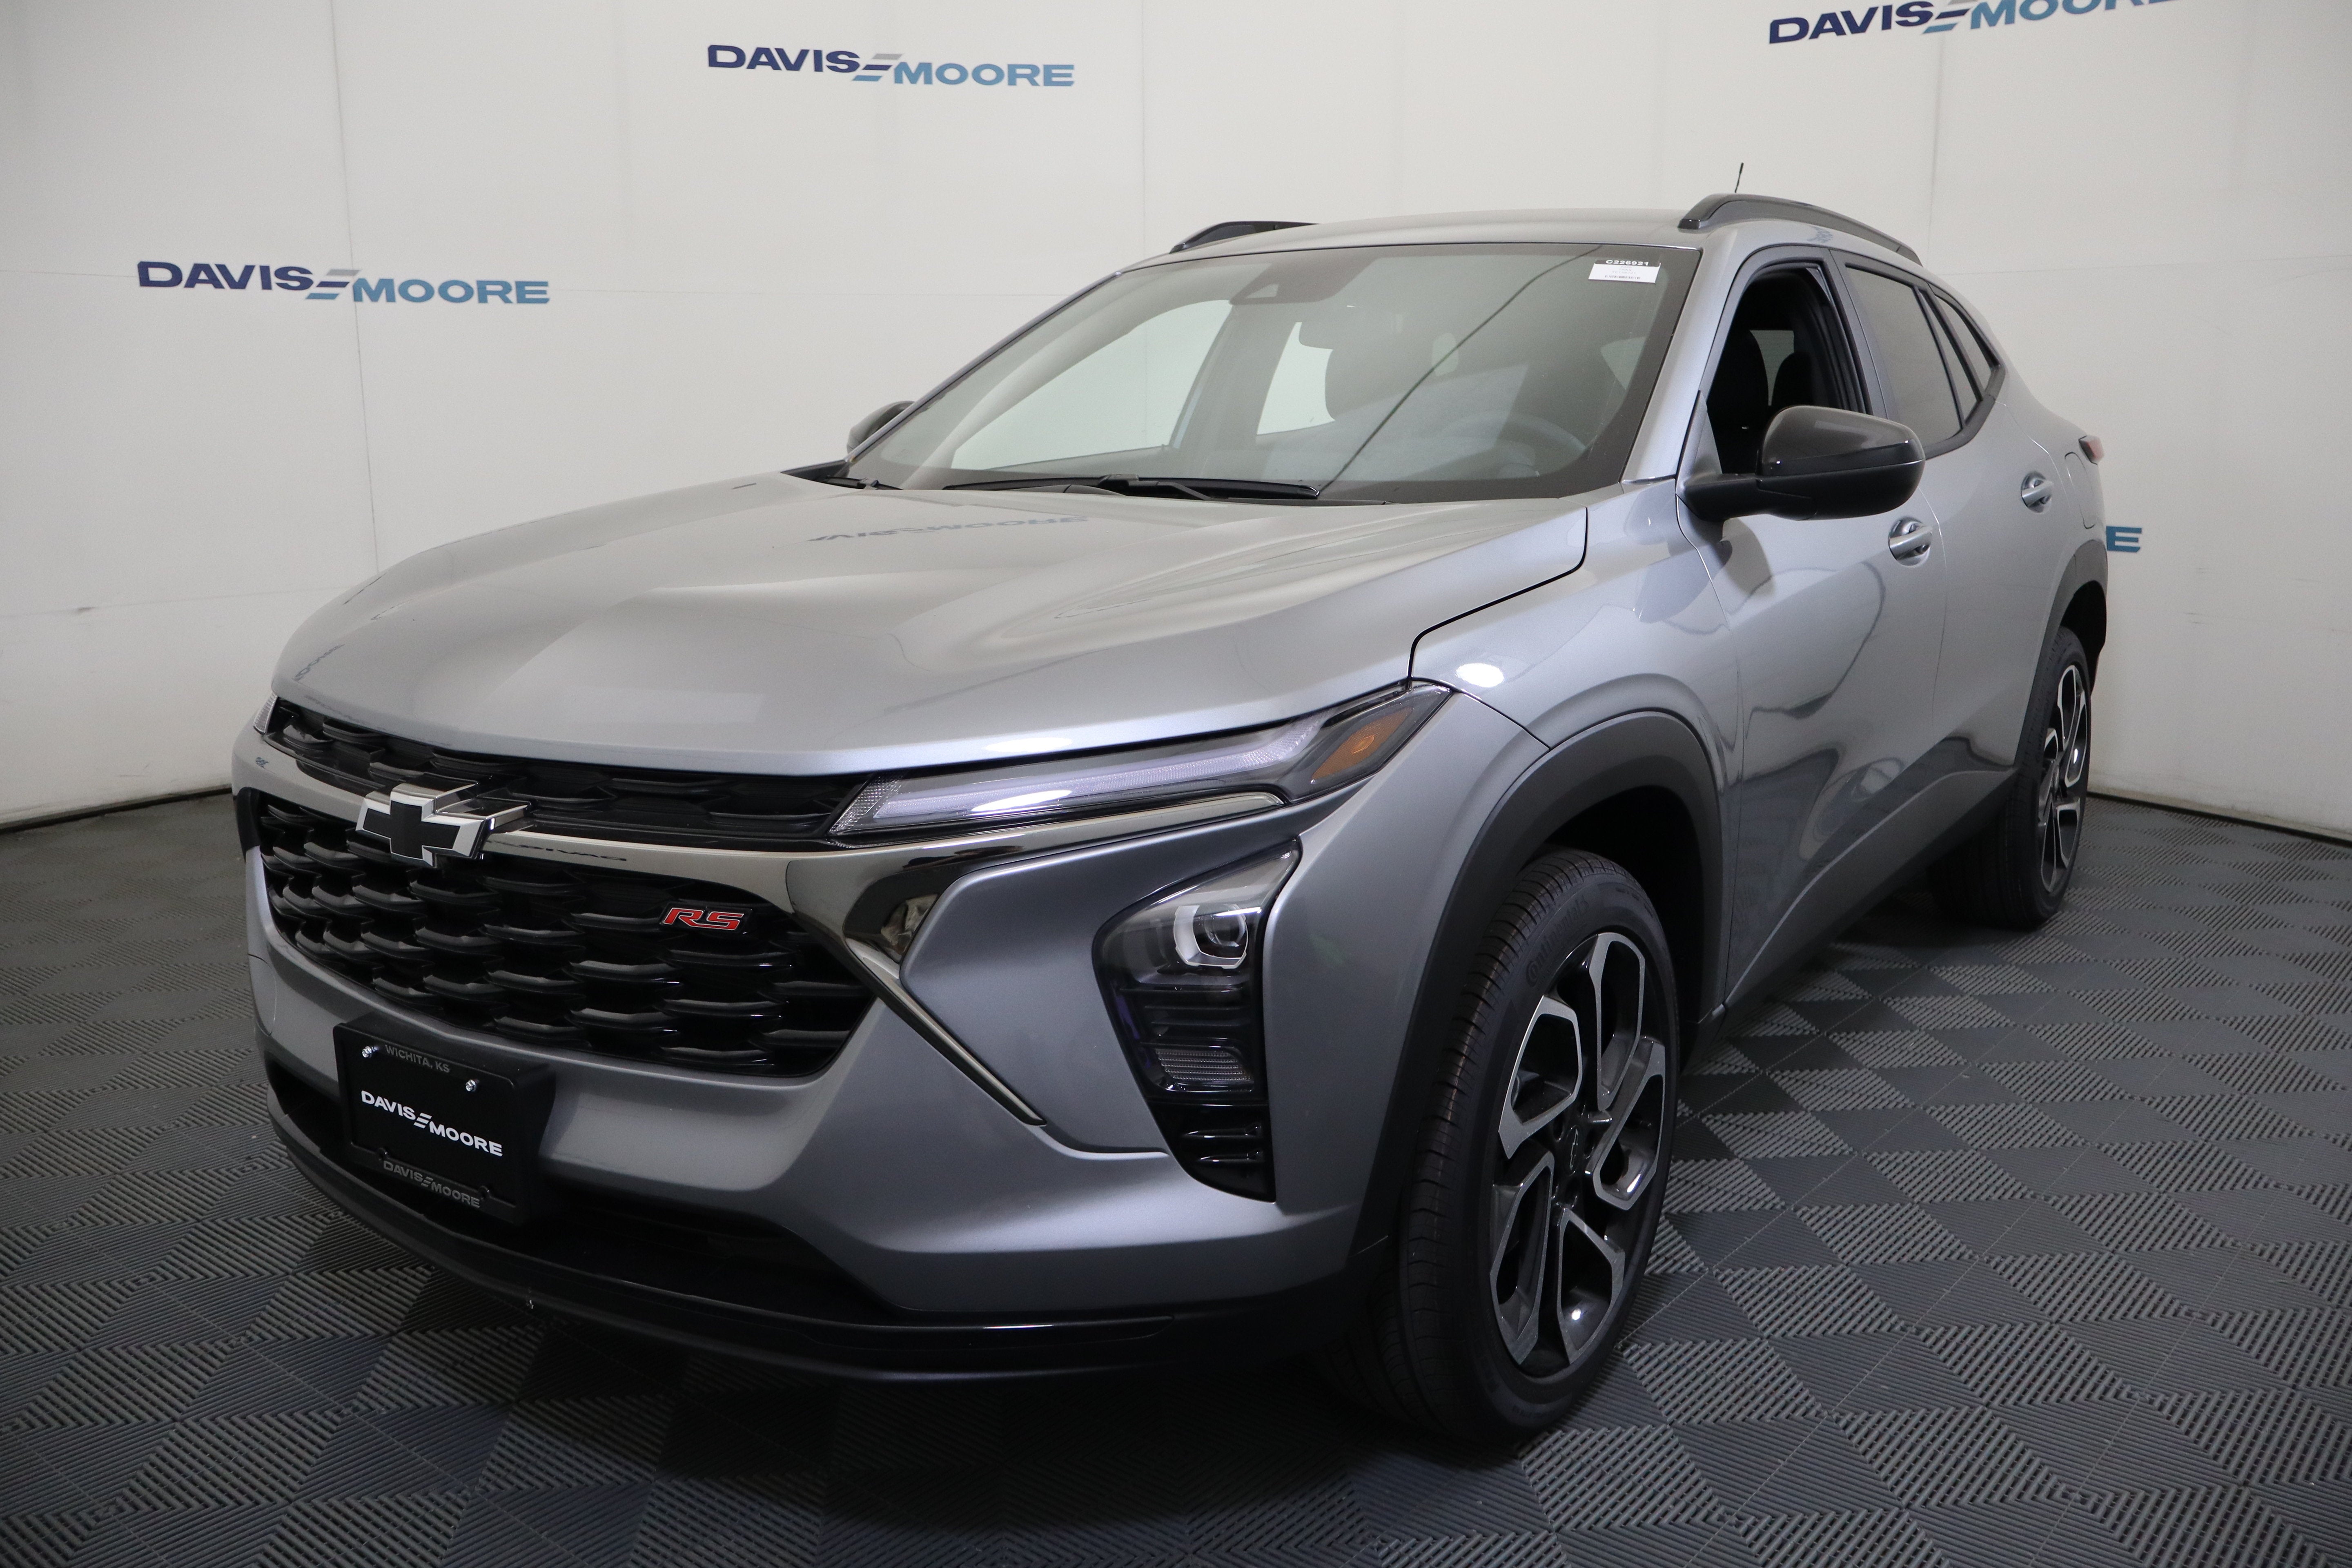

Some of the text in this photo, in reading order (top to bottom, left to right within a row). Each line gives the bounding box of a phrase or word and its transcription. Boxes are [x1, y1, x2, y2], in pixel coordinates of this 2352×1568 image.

[1769, 0, 2174, 45] DAVIS MOO
[707, 44, 1074, 87] DAVIS MOORE
[137, 261, 550, 304] DAVIS MOORE
[663, 907, 744, 931] RS
[385, 1045, 450, 1073] WICHITA, KS
[361, 1090, 503, 1157] DAVIS MOORE
[383, 1160, 480, 1208] DAVIS MOORE
